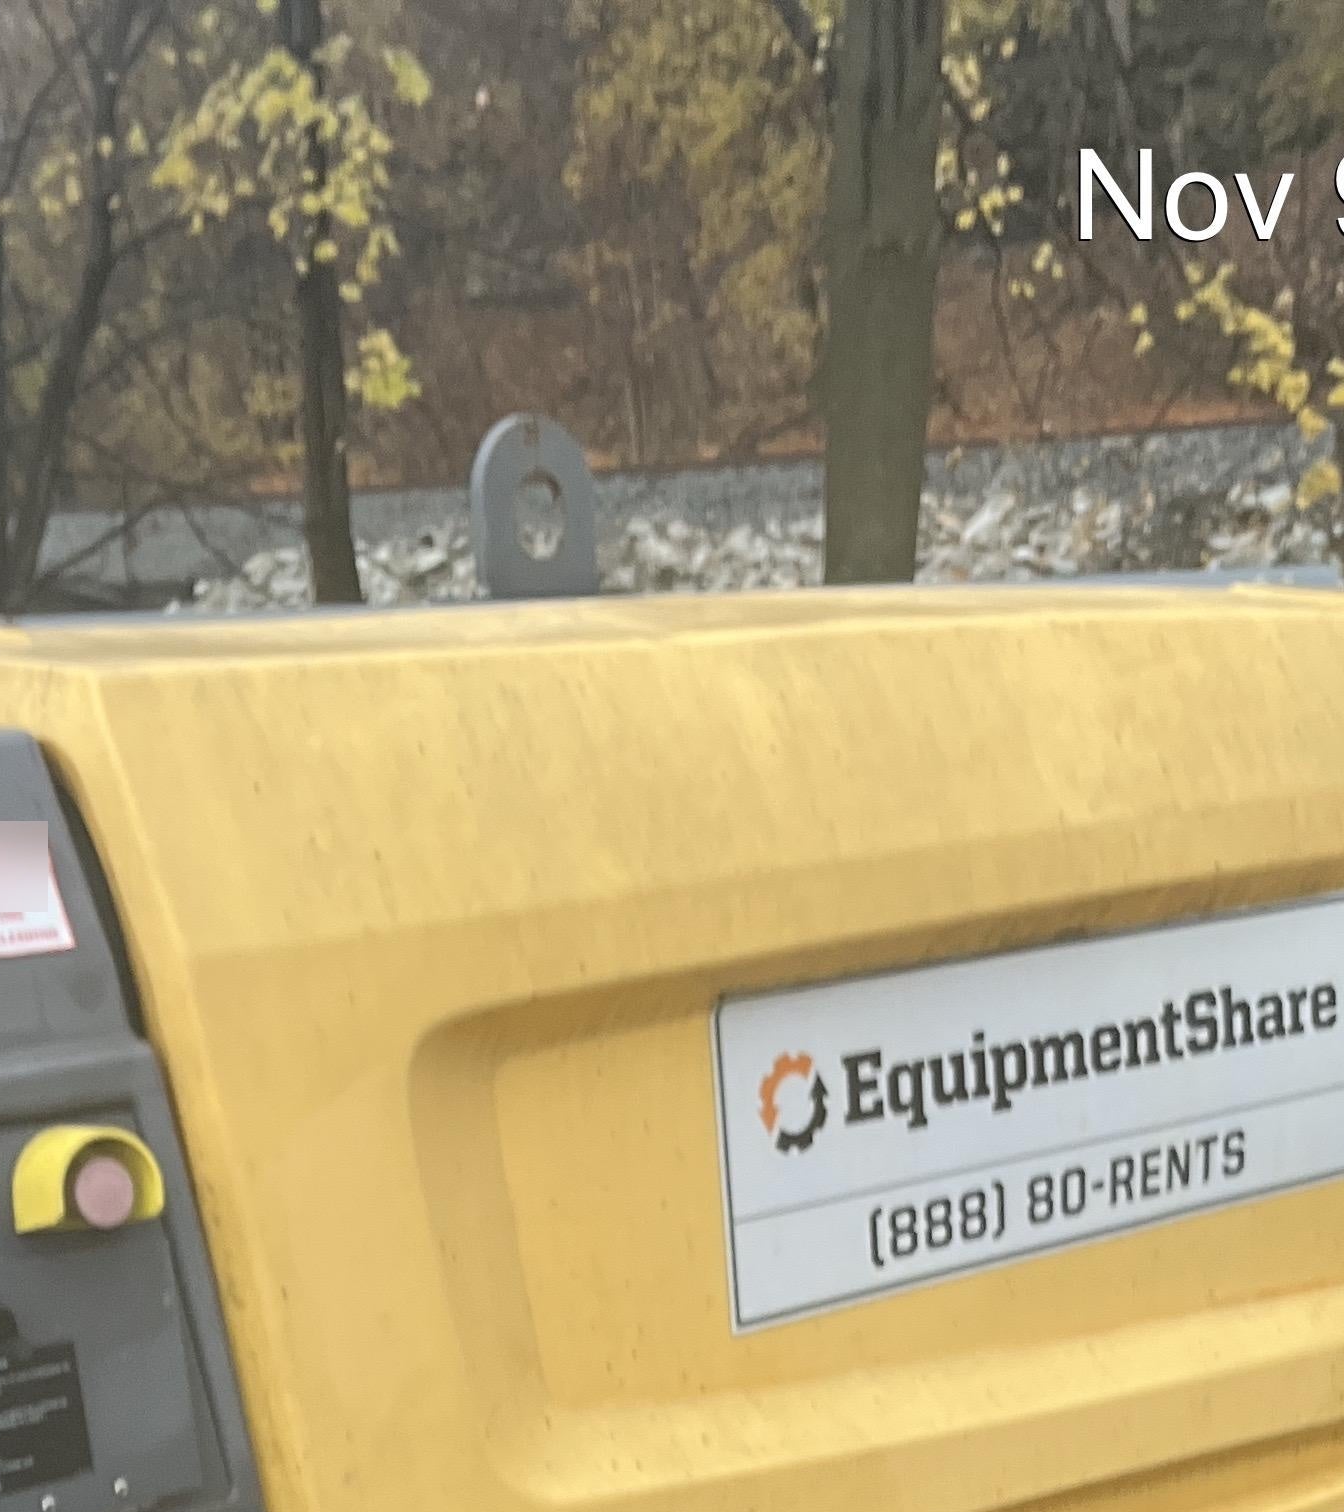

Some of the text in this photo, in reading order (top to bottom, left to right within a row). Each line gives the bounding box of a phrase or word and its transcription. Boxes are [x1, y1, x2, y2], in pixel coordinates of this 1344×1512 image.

[840, 981, 1338, 1132] EquipmentShare
[867, 1130, 1247, 1268] (888) 80-RENTS
